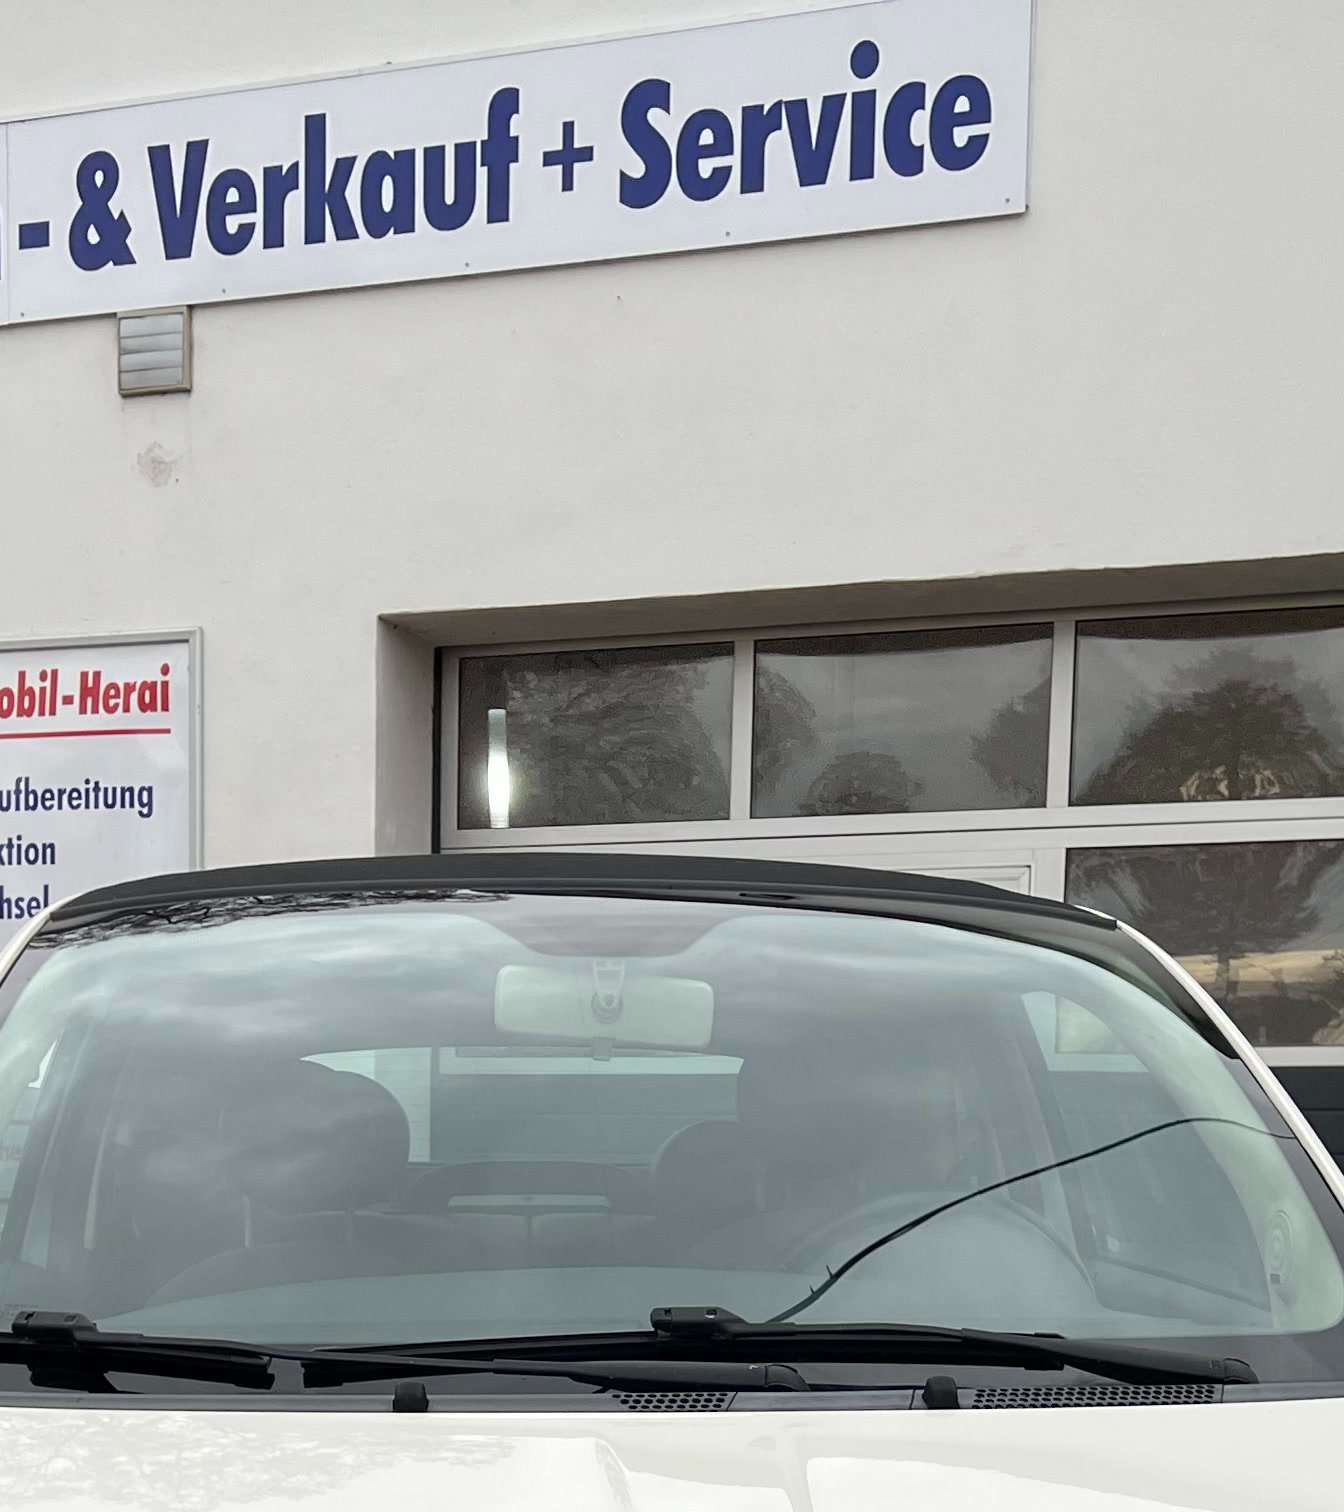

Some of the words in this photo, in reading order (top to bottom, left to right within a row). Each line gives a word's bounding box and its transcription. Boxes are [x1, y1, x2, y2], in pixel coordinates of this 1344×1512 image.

[68, 150, 136, 272] &
[148, 87, 520, 261] Verkauf
[543, 120, 594, 192] +
[619, 39, 992, 209] Service
